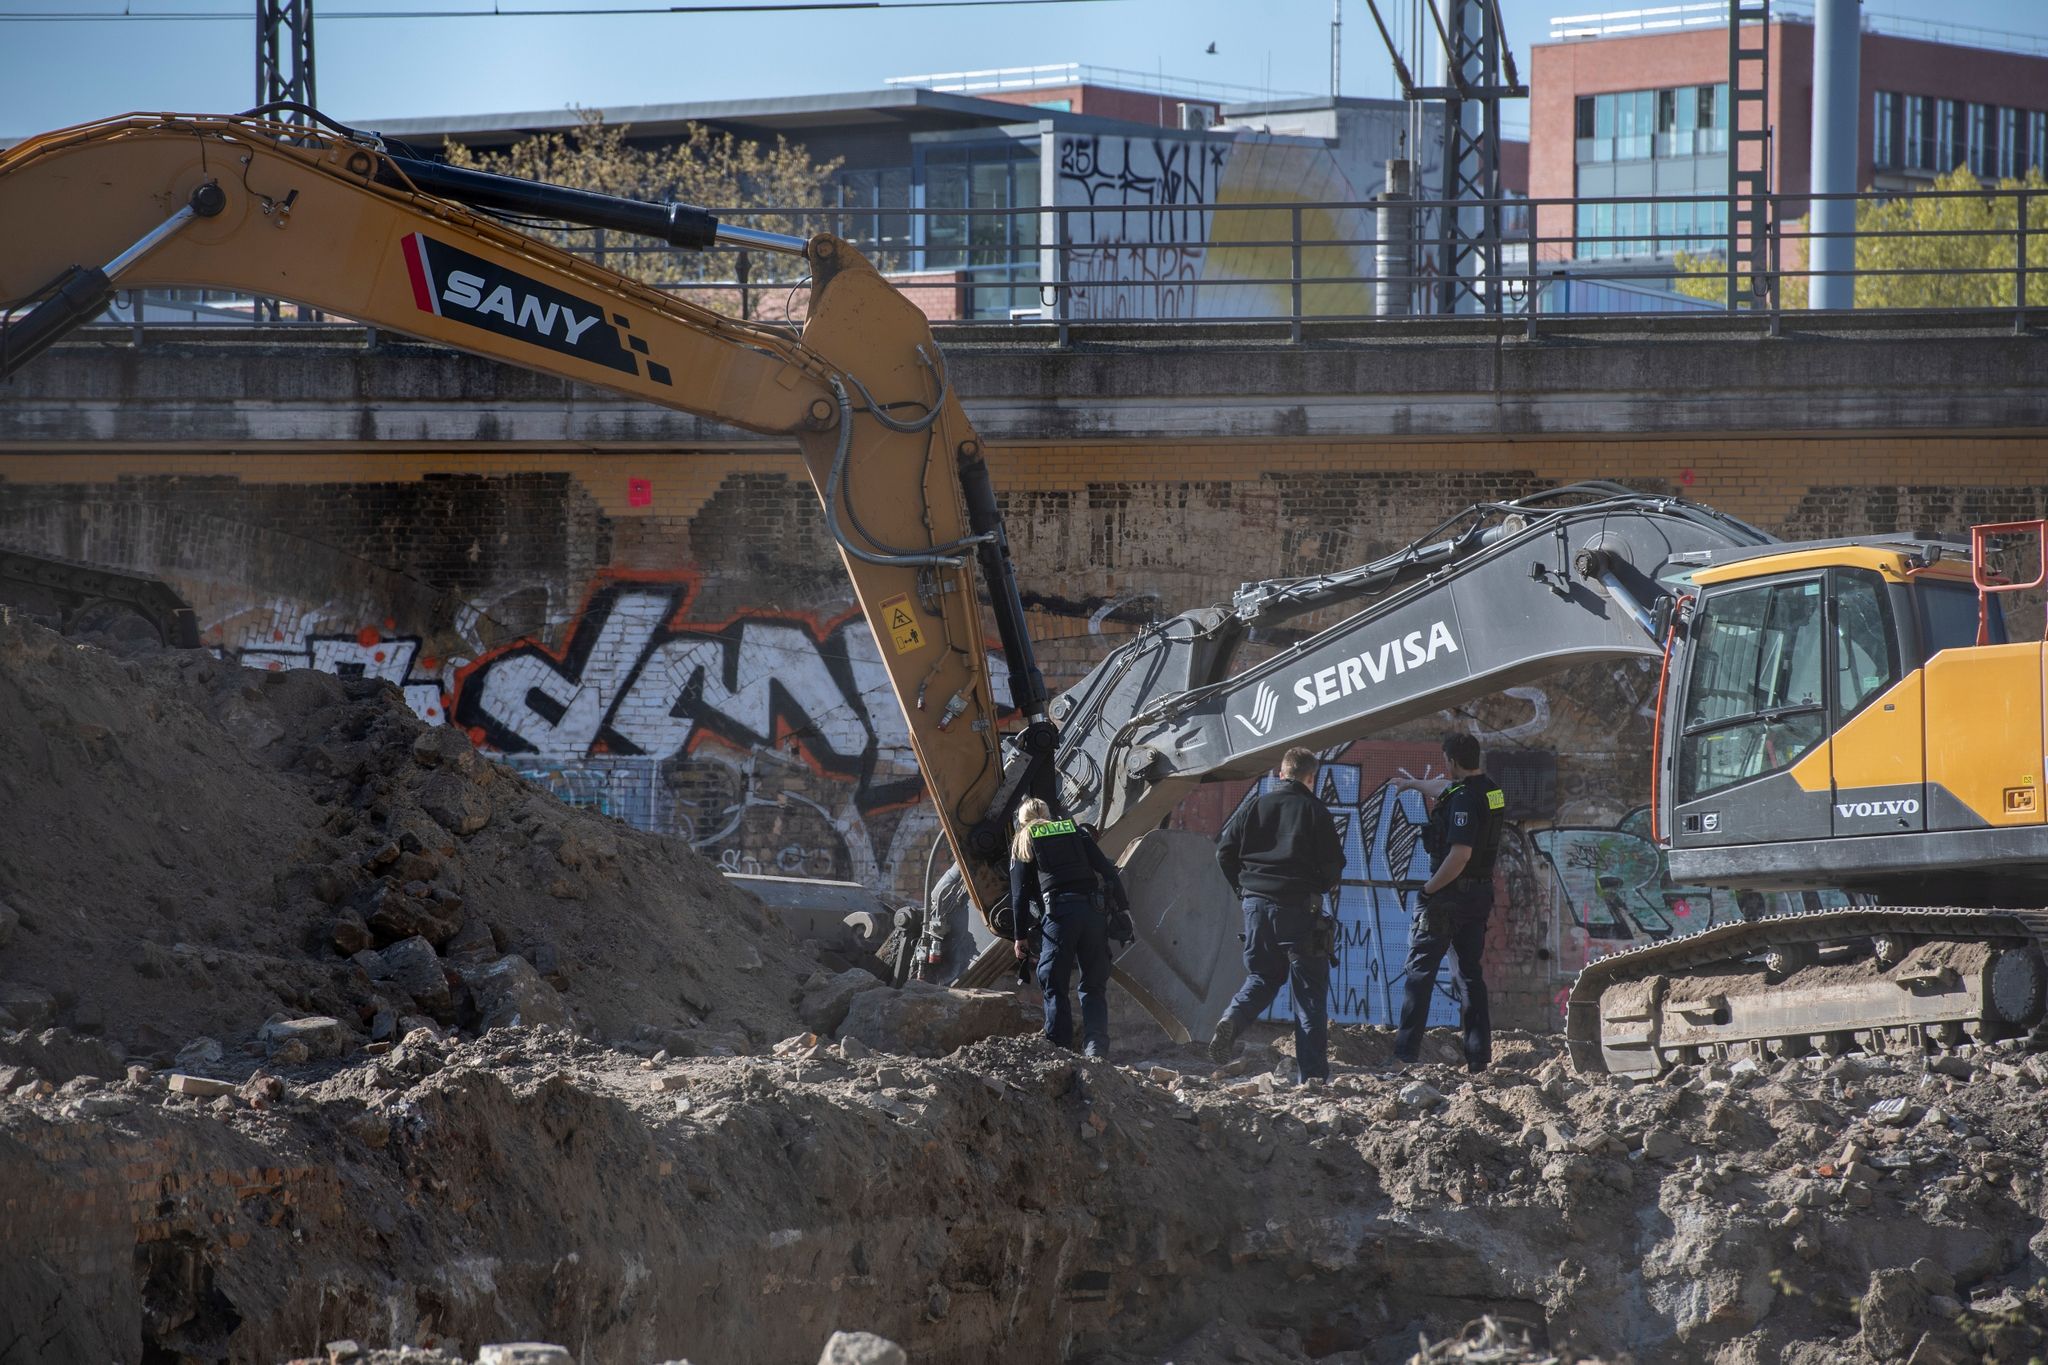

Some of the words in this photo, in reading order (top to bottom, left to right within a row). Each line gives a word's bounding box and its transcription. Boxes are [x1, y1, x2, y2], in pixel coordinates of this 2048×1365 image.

[442, 270, 600, 345] SANY
[1293, 620, 1459, 715] SERVISA
[1031, 821, 1074, 836] POLIZEI
[1836, 799, 1920, 818] VOLVO
